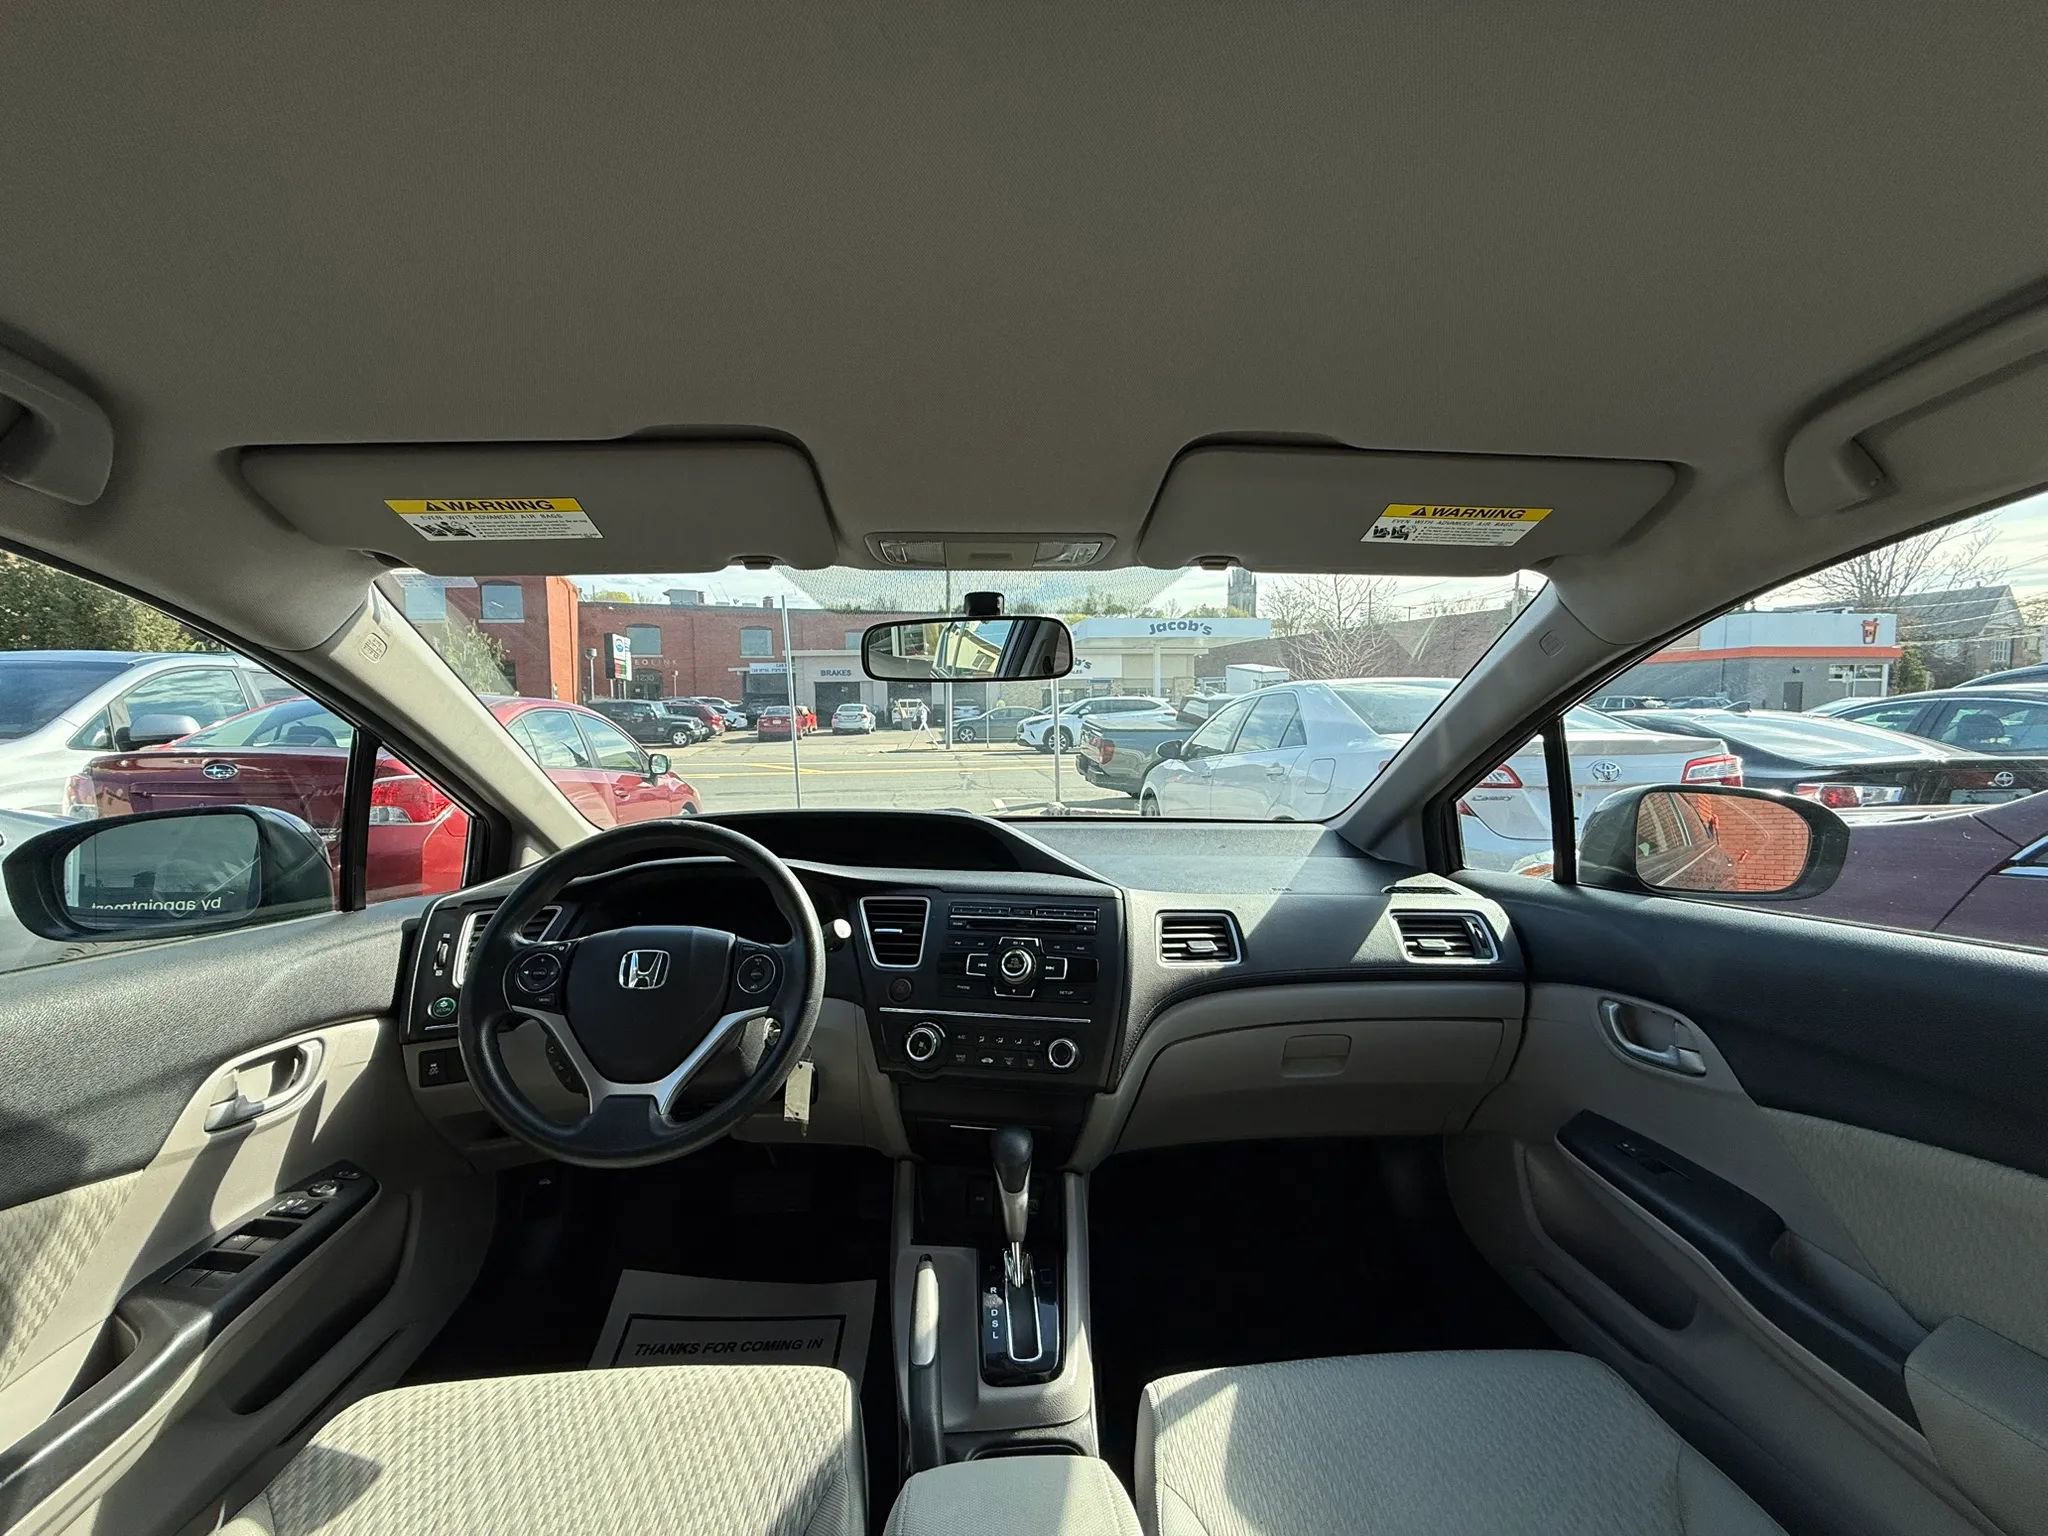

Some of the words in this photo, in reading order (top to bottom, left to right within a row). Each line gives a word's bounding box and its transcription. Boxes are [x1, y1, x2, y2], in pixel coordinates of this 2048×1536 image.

[442, 500, 554, 512] WARNING
[1431, 507, 1527, 519] WARNING
[1148, 619, 1213, 636] Jacob's
[820, 669, 852, 677] BRAKES
[990, 1286, 997, 1294] R
[992, 1331, 999, 1339] L
[634, 1343, 701, 1356] THANKS
[702, 1341, 737, 1354] FOR
[739, 1338, 803, 1353] COMING
[806, 1337, 825, 1350] IN
